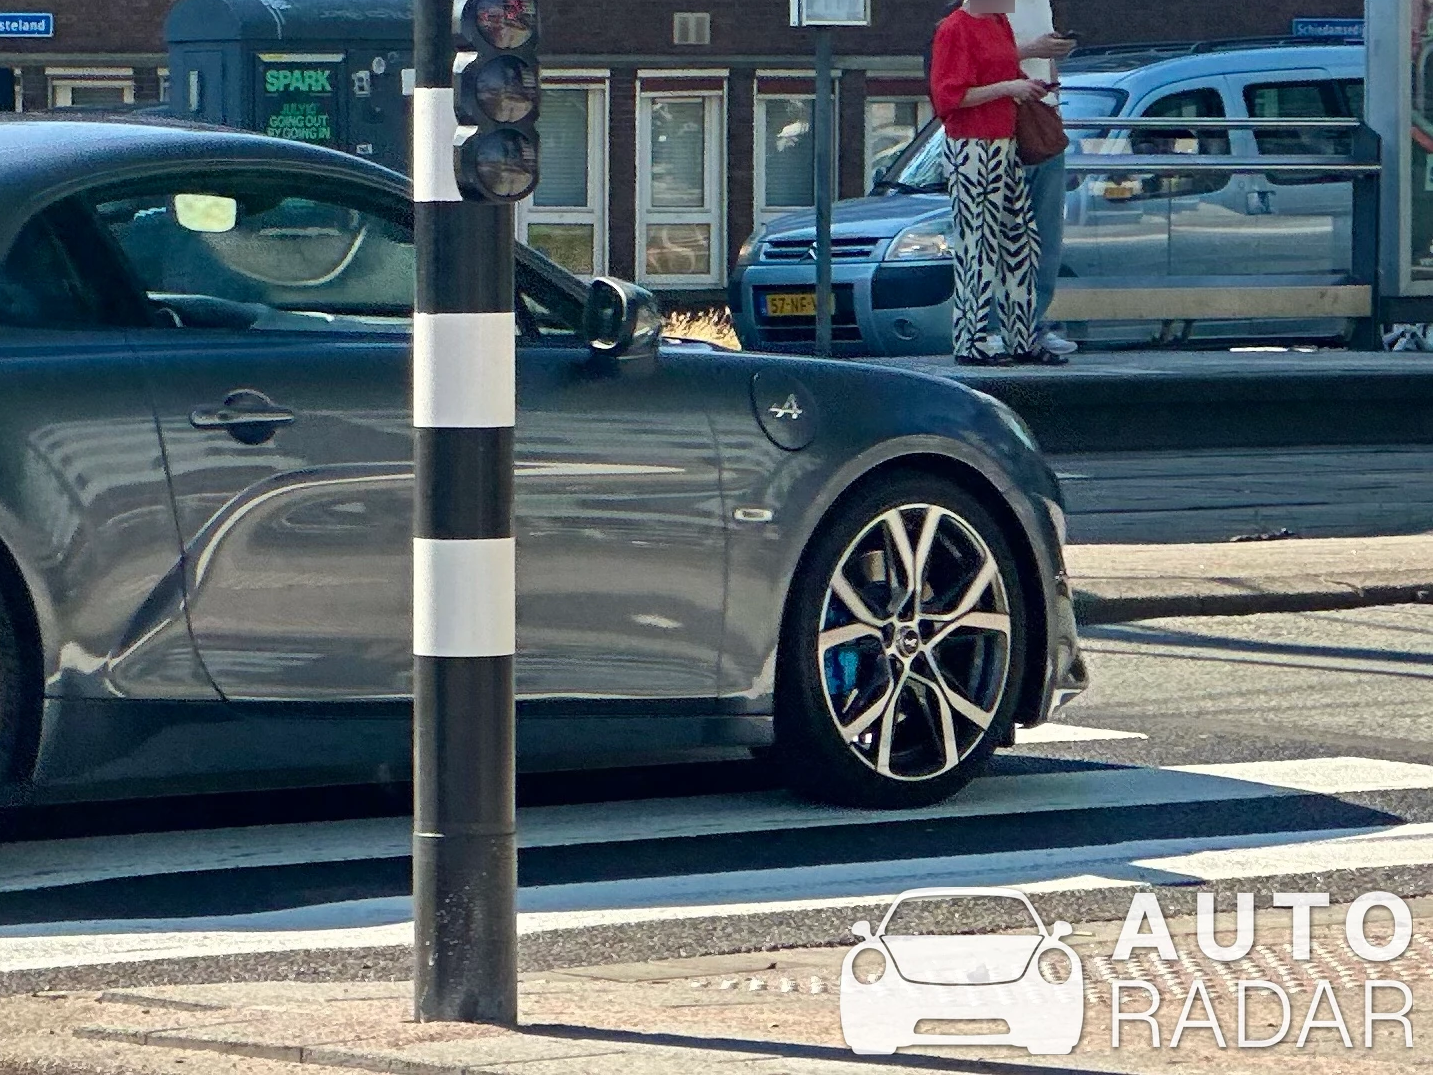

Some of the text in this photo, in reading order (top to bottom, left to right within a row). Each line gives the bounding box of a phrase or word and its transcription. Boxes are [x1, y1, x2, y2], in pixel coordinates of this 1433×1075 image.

[265, 69, 333, 93] SPARK
[269, 115, 329, 128] GOING OUT
[770, 296, 816, 314] 57-NF-
